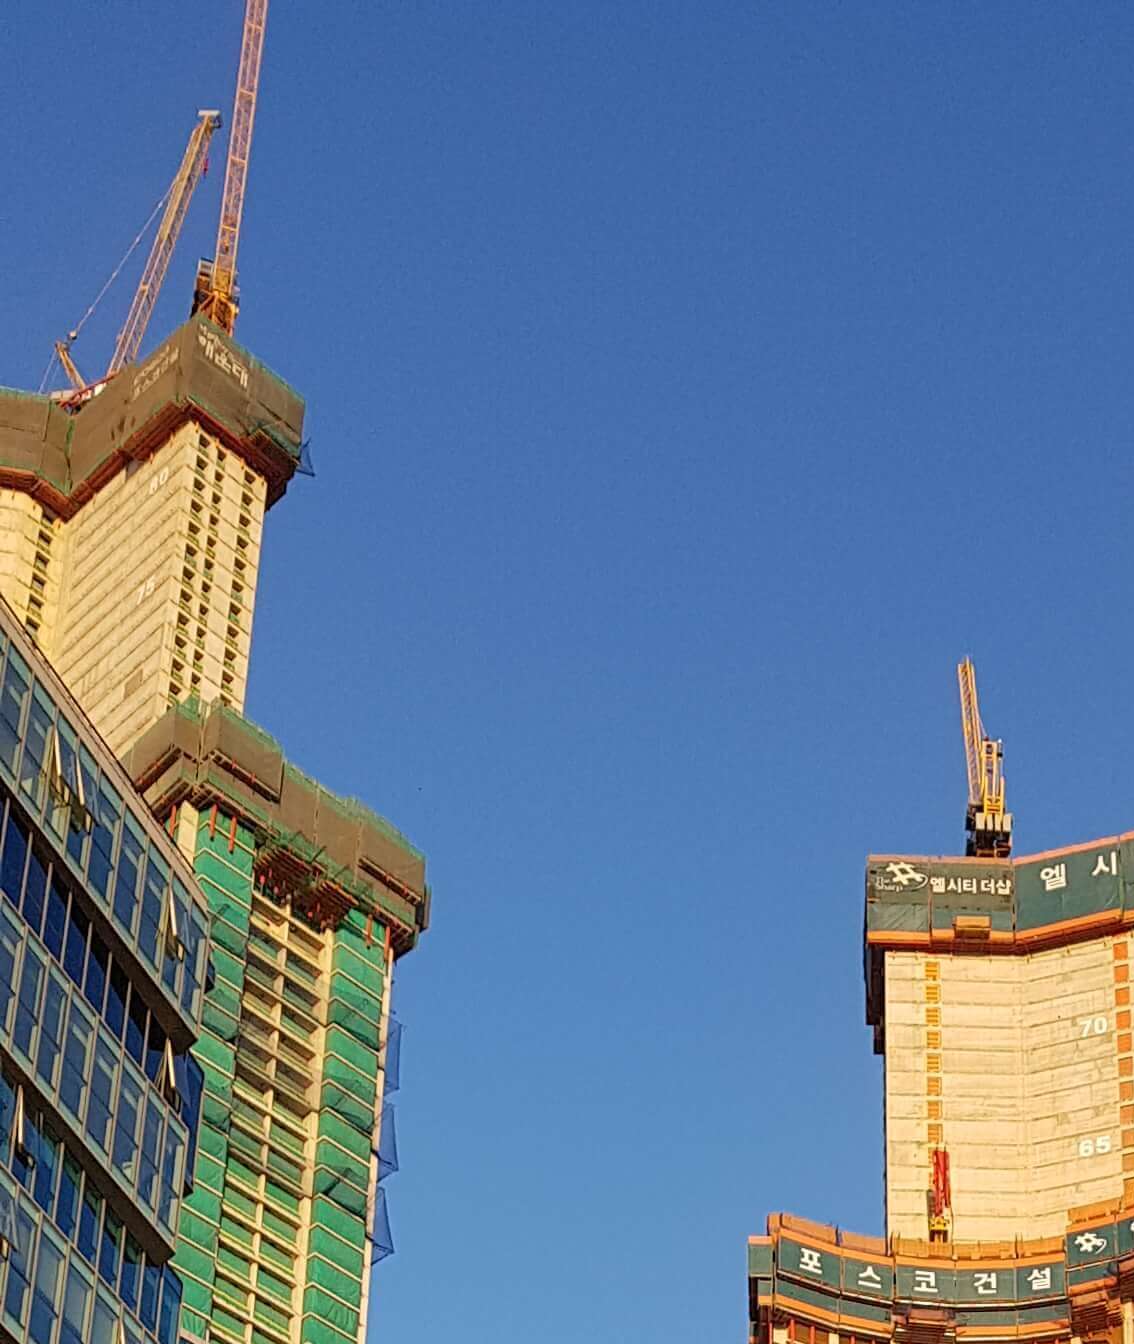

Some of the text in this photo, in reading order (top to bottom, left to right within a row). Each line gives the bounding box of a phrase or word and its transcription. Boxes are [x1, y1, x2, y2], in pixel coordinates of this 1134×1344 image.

[929, 877, 1012, 895] 엘시티 더샵
[1079, 1016, 1108, 1039] 70
[1078, 1135, 1112, 1158] 65
